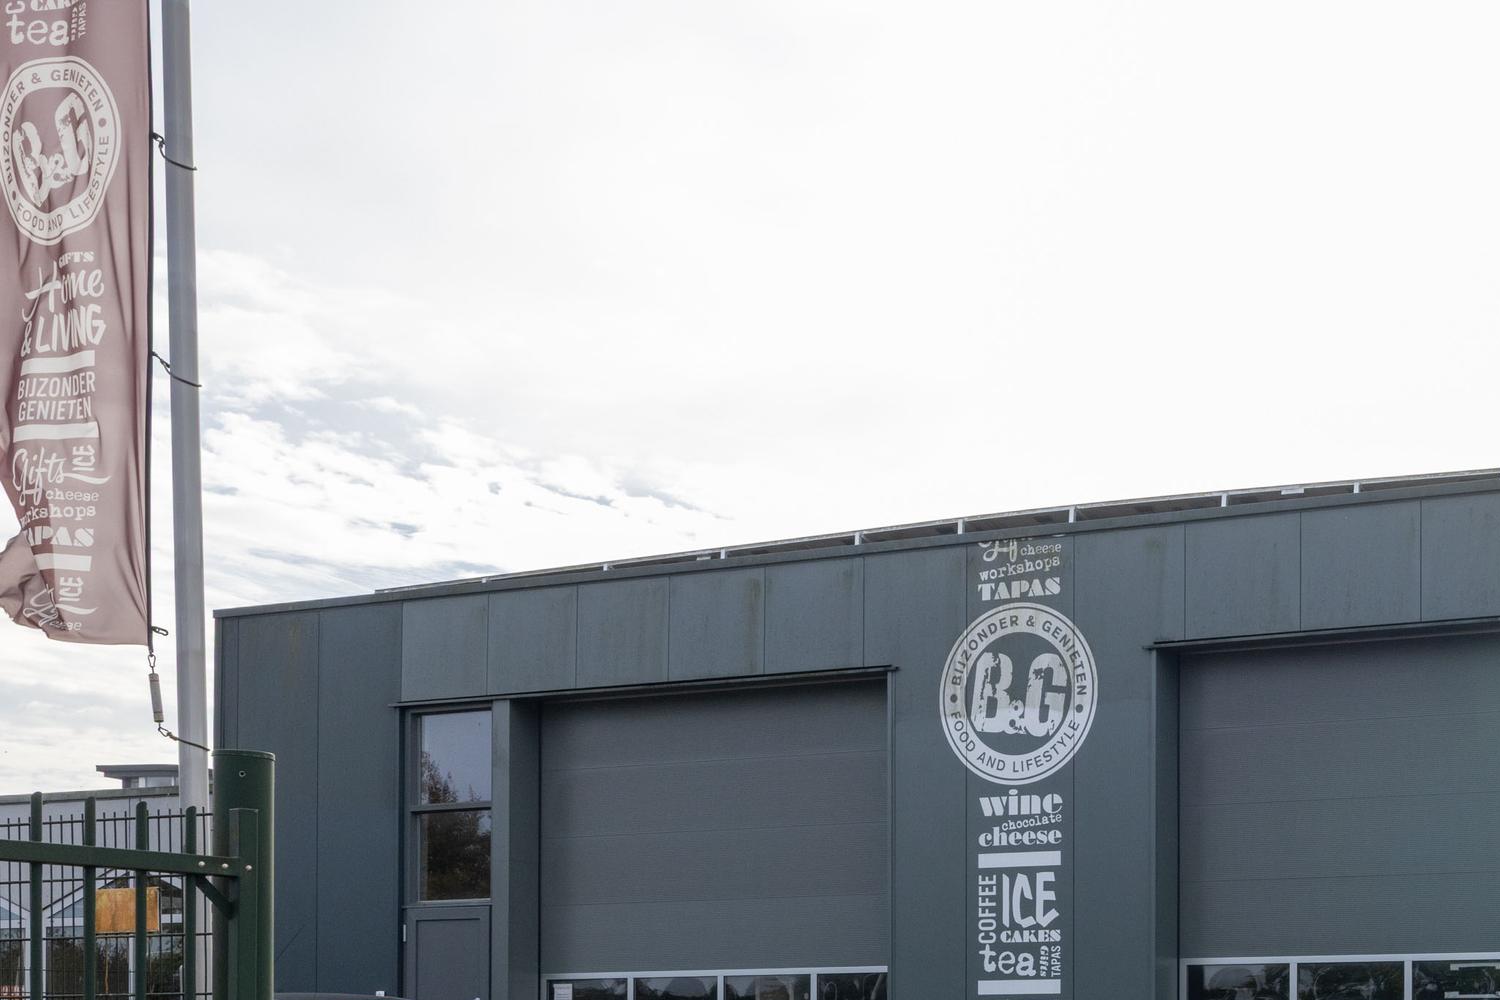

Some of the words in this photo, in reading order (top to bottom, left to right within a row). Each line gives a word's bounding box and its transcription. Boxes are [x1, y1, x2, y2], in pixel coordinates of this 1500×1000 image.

[6, 14, 70, 46] tea
[31, 72, 42, 84] &
[50, 69, 104, 112] GENIETEN
[16, 203, 45, 232] FOOD
[47, 214, 63, 232] AND
[69, 139, 110, 218] LIFESTYLE
[58, 251, 95, 269] GIFTS
[22, 260, 105, 322] Home
[21, 321, 33, 357] &
[35, 304, 107, 353] LIVING
[17, 371, 96, 401] BIJZONDER
[18, 396, 92, 422] GENIETEN
[71, 446, 96, 472] ICE
[12, 447, 112, 506] Gifts
[45, 485, 100, 502] cheese
[1020, 543, 1062, 556] cheese
[978, 556, 1061, 582] workshops
[58, 576, 84, 602] ICE
[977, 576, 1061, 601] TAPAS
[951, 615, 1019, 686] BIJZONDER
[1026, 615, 1035, 627] &
[1042, 620, 1087, 696] GENIETEN
[951, 711, 976, 752] FOOD
[977, 752, 1006, 771] AND
[1012, 720, 1080, 773] LIFESTYLE
[979, 789, 1063, 817] wine
[978, 826, 1063, 847] cheese
[1001, 813, 1062, 831] chocolate
[977, 874, 997, 944] COFFEE
[1002, 871, 1060, 928] ICE
[1000, 929, 1061, 943] CAKES
[978, 943, 1036, 977] tea
[1050, 945, 1061, 977] TAPAS
